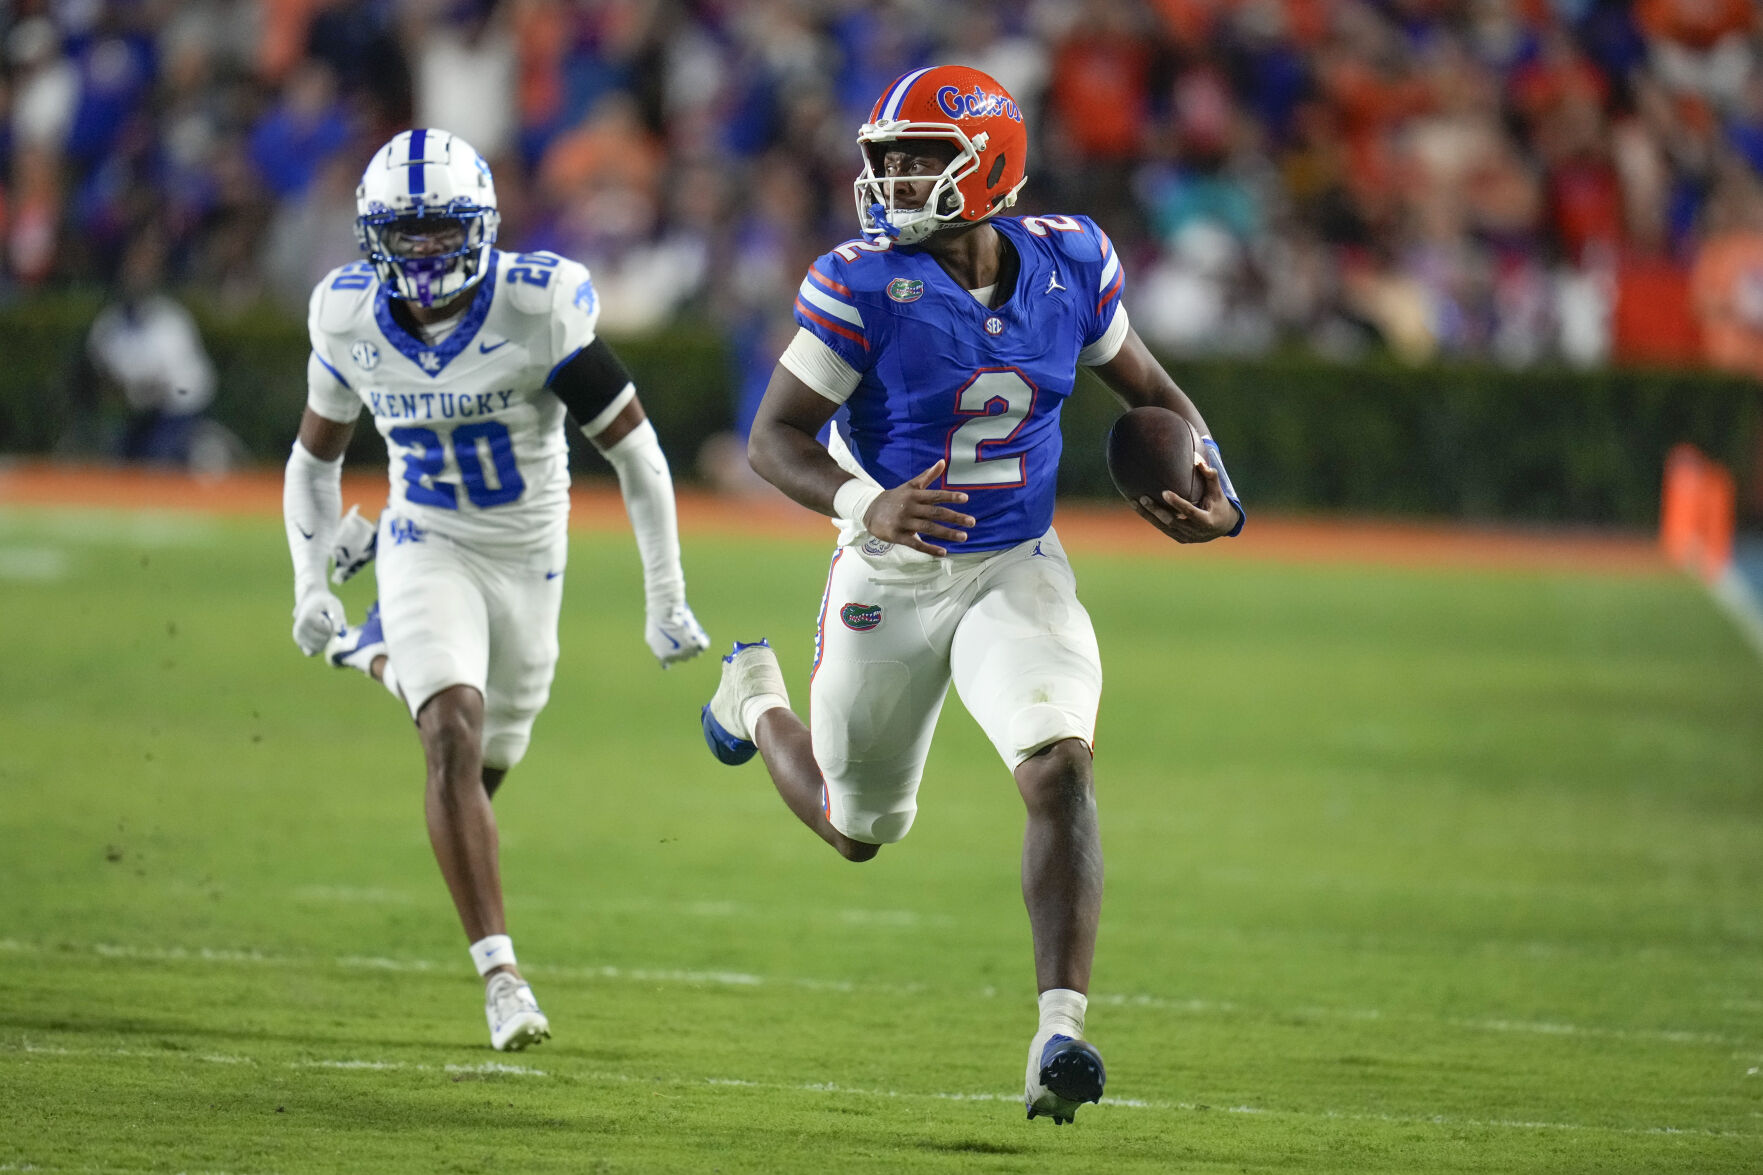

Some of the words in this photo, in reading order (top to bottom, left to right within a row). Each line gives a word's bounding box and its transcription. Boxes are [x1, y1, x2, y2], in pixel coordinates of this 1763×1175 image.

[1020, 215, 1085, 237] 2
[506, 254, 559, 289] 20
[987, 317, 1002, 333] SEC
[371, 390, 514, 419] KENTUCKY
[941, 366, 1039, 490] 2
[389, 421, 526, 510] 20
